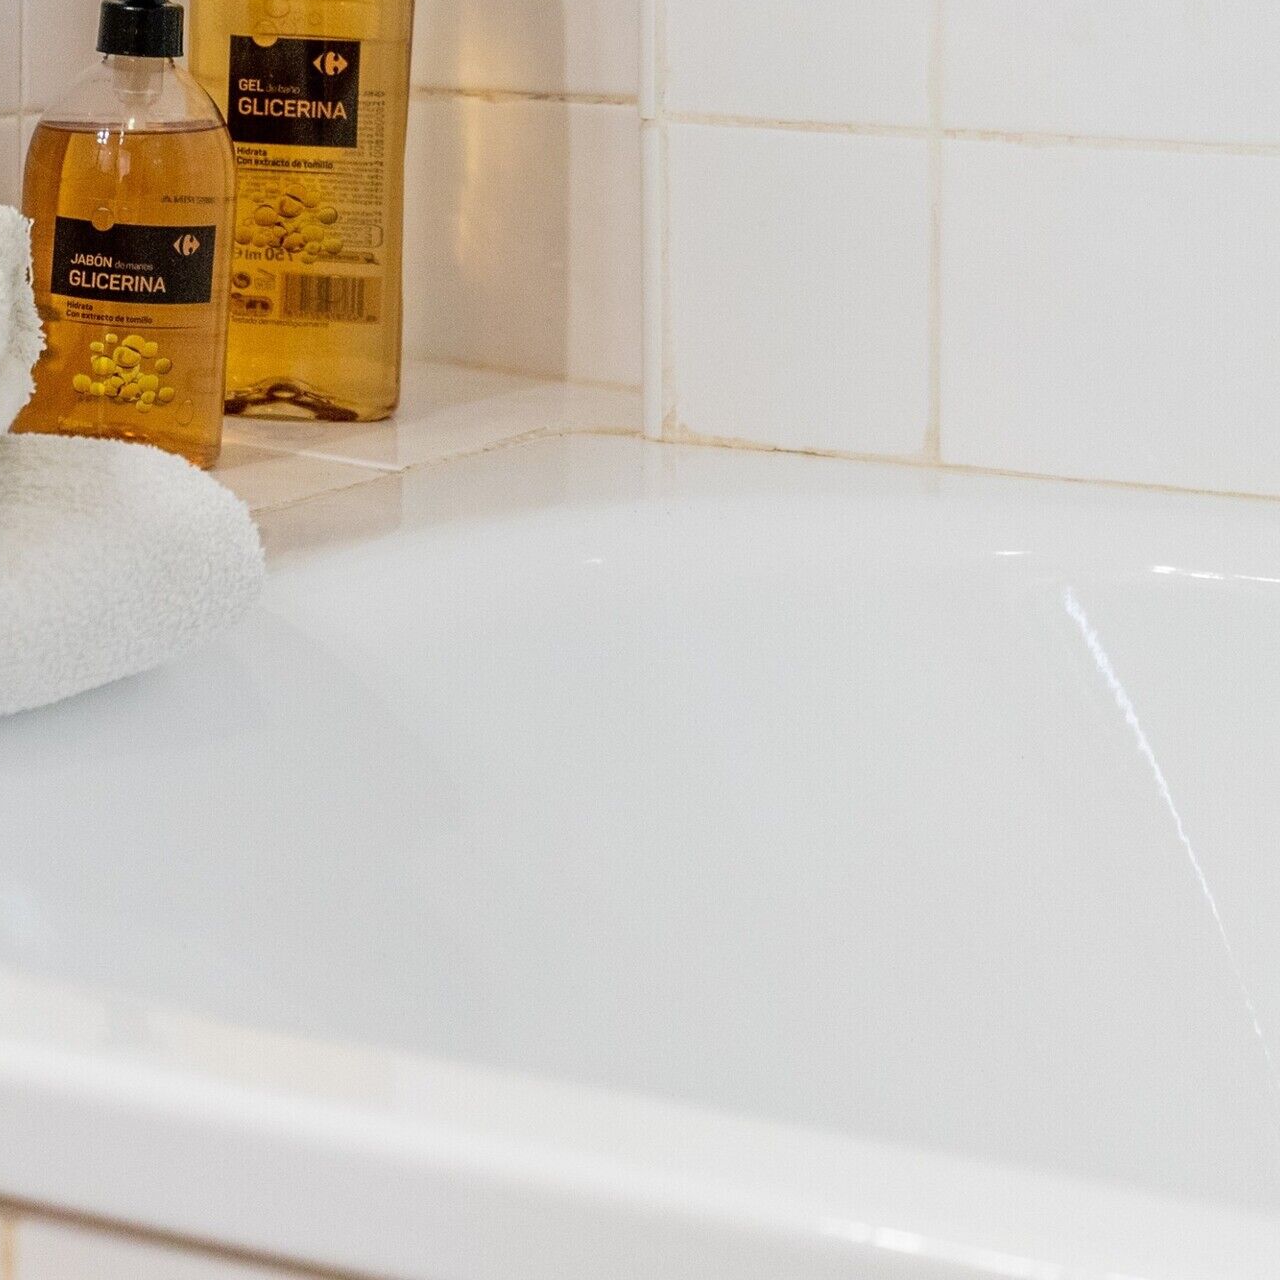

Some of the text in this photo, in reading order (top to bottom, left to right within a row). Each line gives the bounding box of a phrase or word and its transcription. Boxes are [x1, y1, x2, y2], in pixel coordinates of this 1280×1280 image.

[238, 78, 264, 92] GEL
[238, 97, 347, 120] GLICERINA
[237, 147, 267, 156] Hidrata
[237, 157, 252, 165] Con
[254, 159, 290, 167] extracto
[304, 161, 333, 169] tomillo
[70, 253, 113, 268] JABÓN
[69, 269, 166, 293] GLICERINA
[67, 301, 93, 311] Hidrata
[81, 313, 114, 321] extracto
